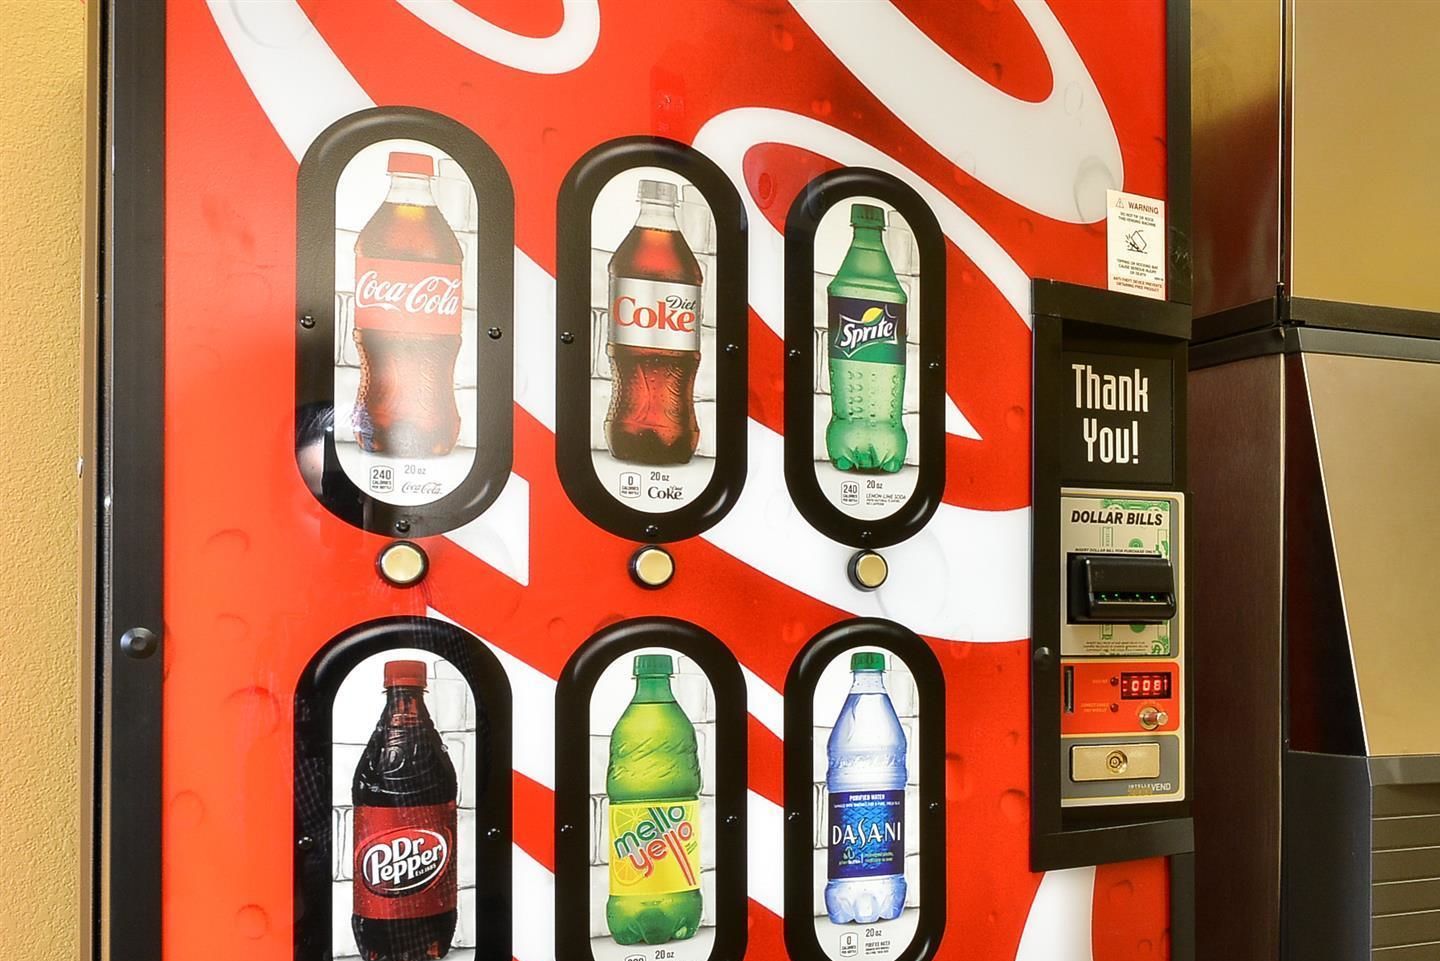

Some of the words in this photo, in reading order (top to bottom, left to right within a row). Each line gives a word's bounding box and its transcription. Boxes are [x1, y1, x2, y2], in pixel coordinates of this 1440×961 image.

[1128, 201, 1159, 214] WARNING
[356, 270, 462, 315] Coca-Cola
[666, 295, 696, 310] Diet
[613, 296, 696, 332] Coke
[840, 316, 893, 349] Sprite
[1072, 363, 1149, 412] Thank
[1083, 418, 1139, 464] You!
[372, 469, 392, 480] 240
[404, 464, 416, 474] 20
[628, 476, 634, 486] 0
[650, 472, 660, 481] 20
[401, 481, 442, 494] Coca-Cola
[843, 484, 857, 494] 240
[866, 480, 875, 489] 20
[648, 486, 682, 500] Coke
[1071, 510, 1123, 524] DOLLAR
[1126, 513, 1163, 526] BILLS
[614, 806, 685, 859] mello
[832, 816, 901, 849] DASANI
[391, 837, 425, 863] Dr
[629, 822, 696, 886] yello
[364, 844, 442, 886] Pepper
[865, 928, 874, 937] 20
[847, 936, 851, 945] 0
[655, 950, 665, 959] 20
